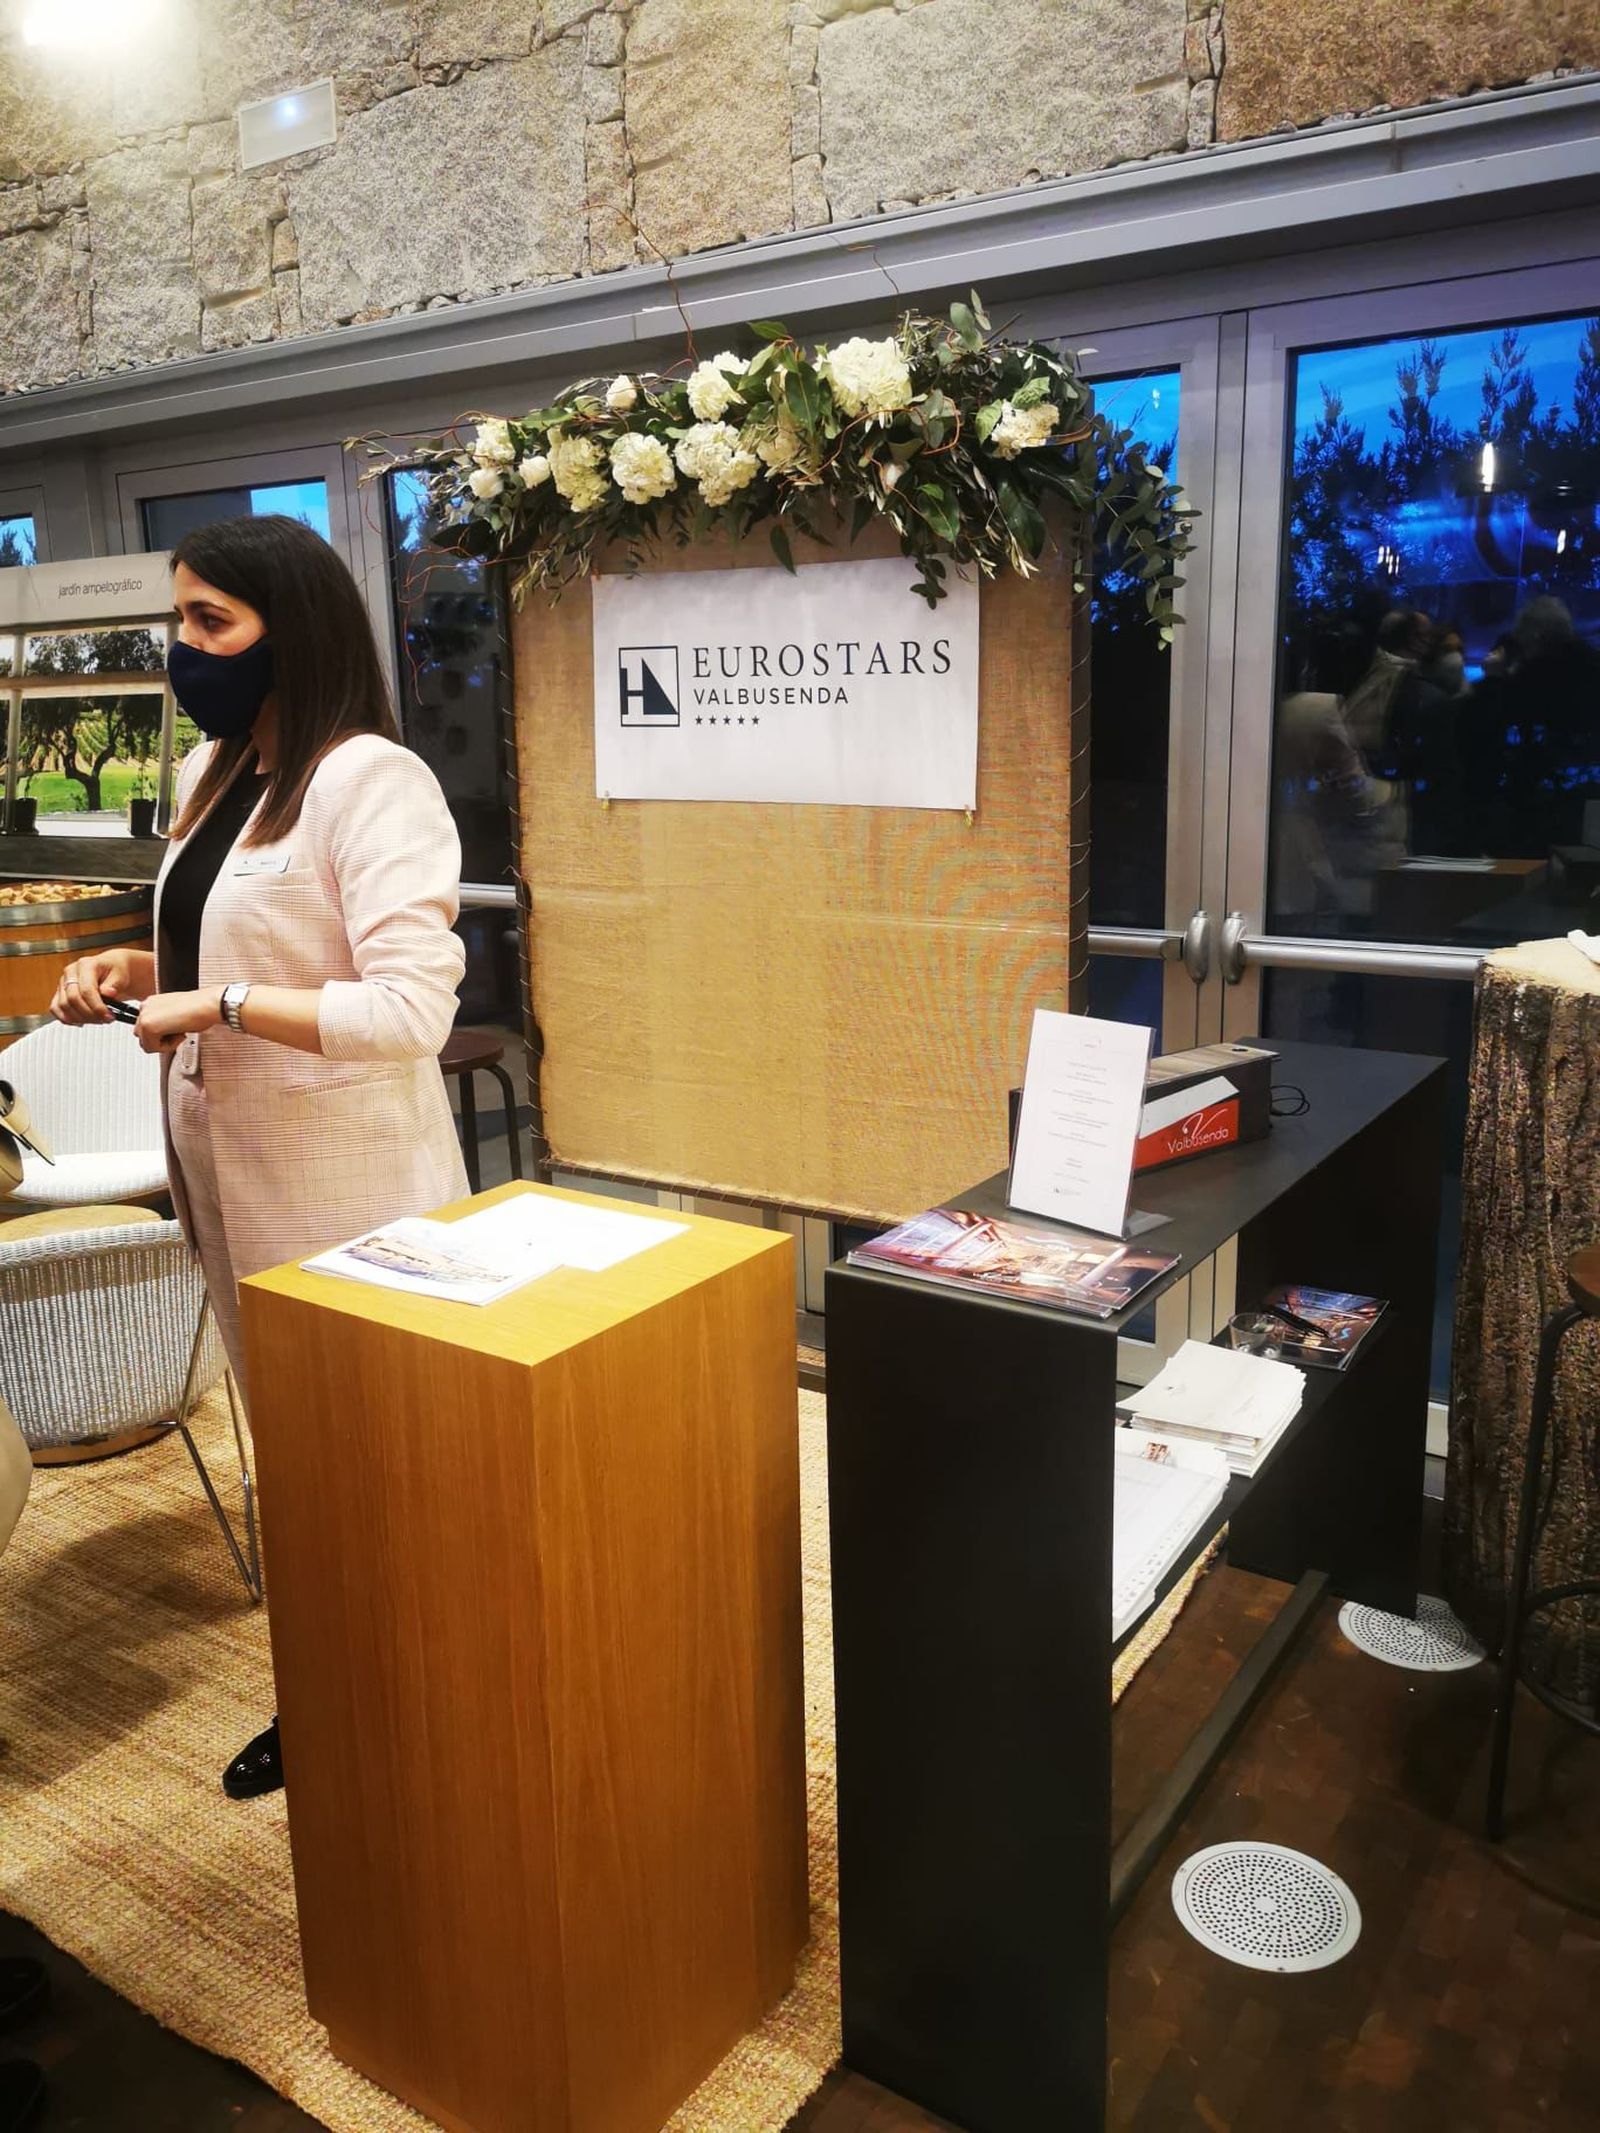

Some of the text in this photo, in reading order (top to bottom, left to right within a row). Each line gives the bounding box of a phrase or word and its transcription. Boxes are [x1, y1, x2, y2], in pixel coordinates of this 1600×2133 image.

[83, 578, 142, 596] ampelográfico
[692, 639, 951, 678] EUROSTARS
[693, 686, 849, 706] VALBUSENDA
[1167, 1127, 1229, 1154] Valbusenda
